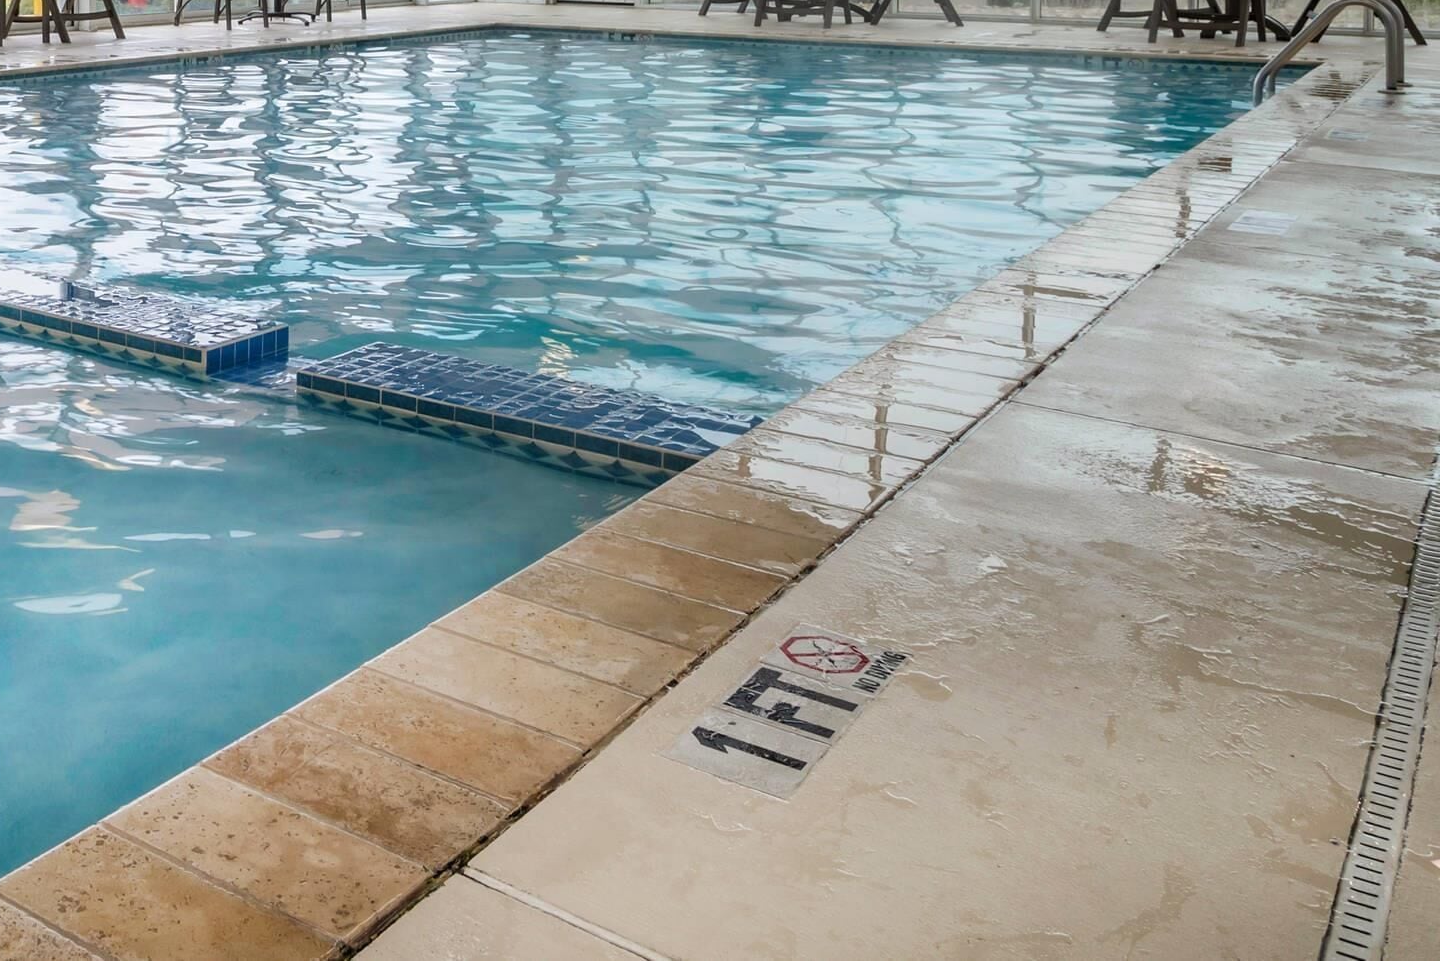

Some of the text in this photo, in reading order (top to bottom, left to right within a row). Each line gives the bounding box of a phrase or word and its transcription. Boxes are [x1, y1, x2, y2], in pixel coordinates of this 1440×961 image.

[852, 677, 881, 693] NO
[691, 666, 859, 771] 1 FT
